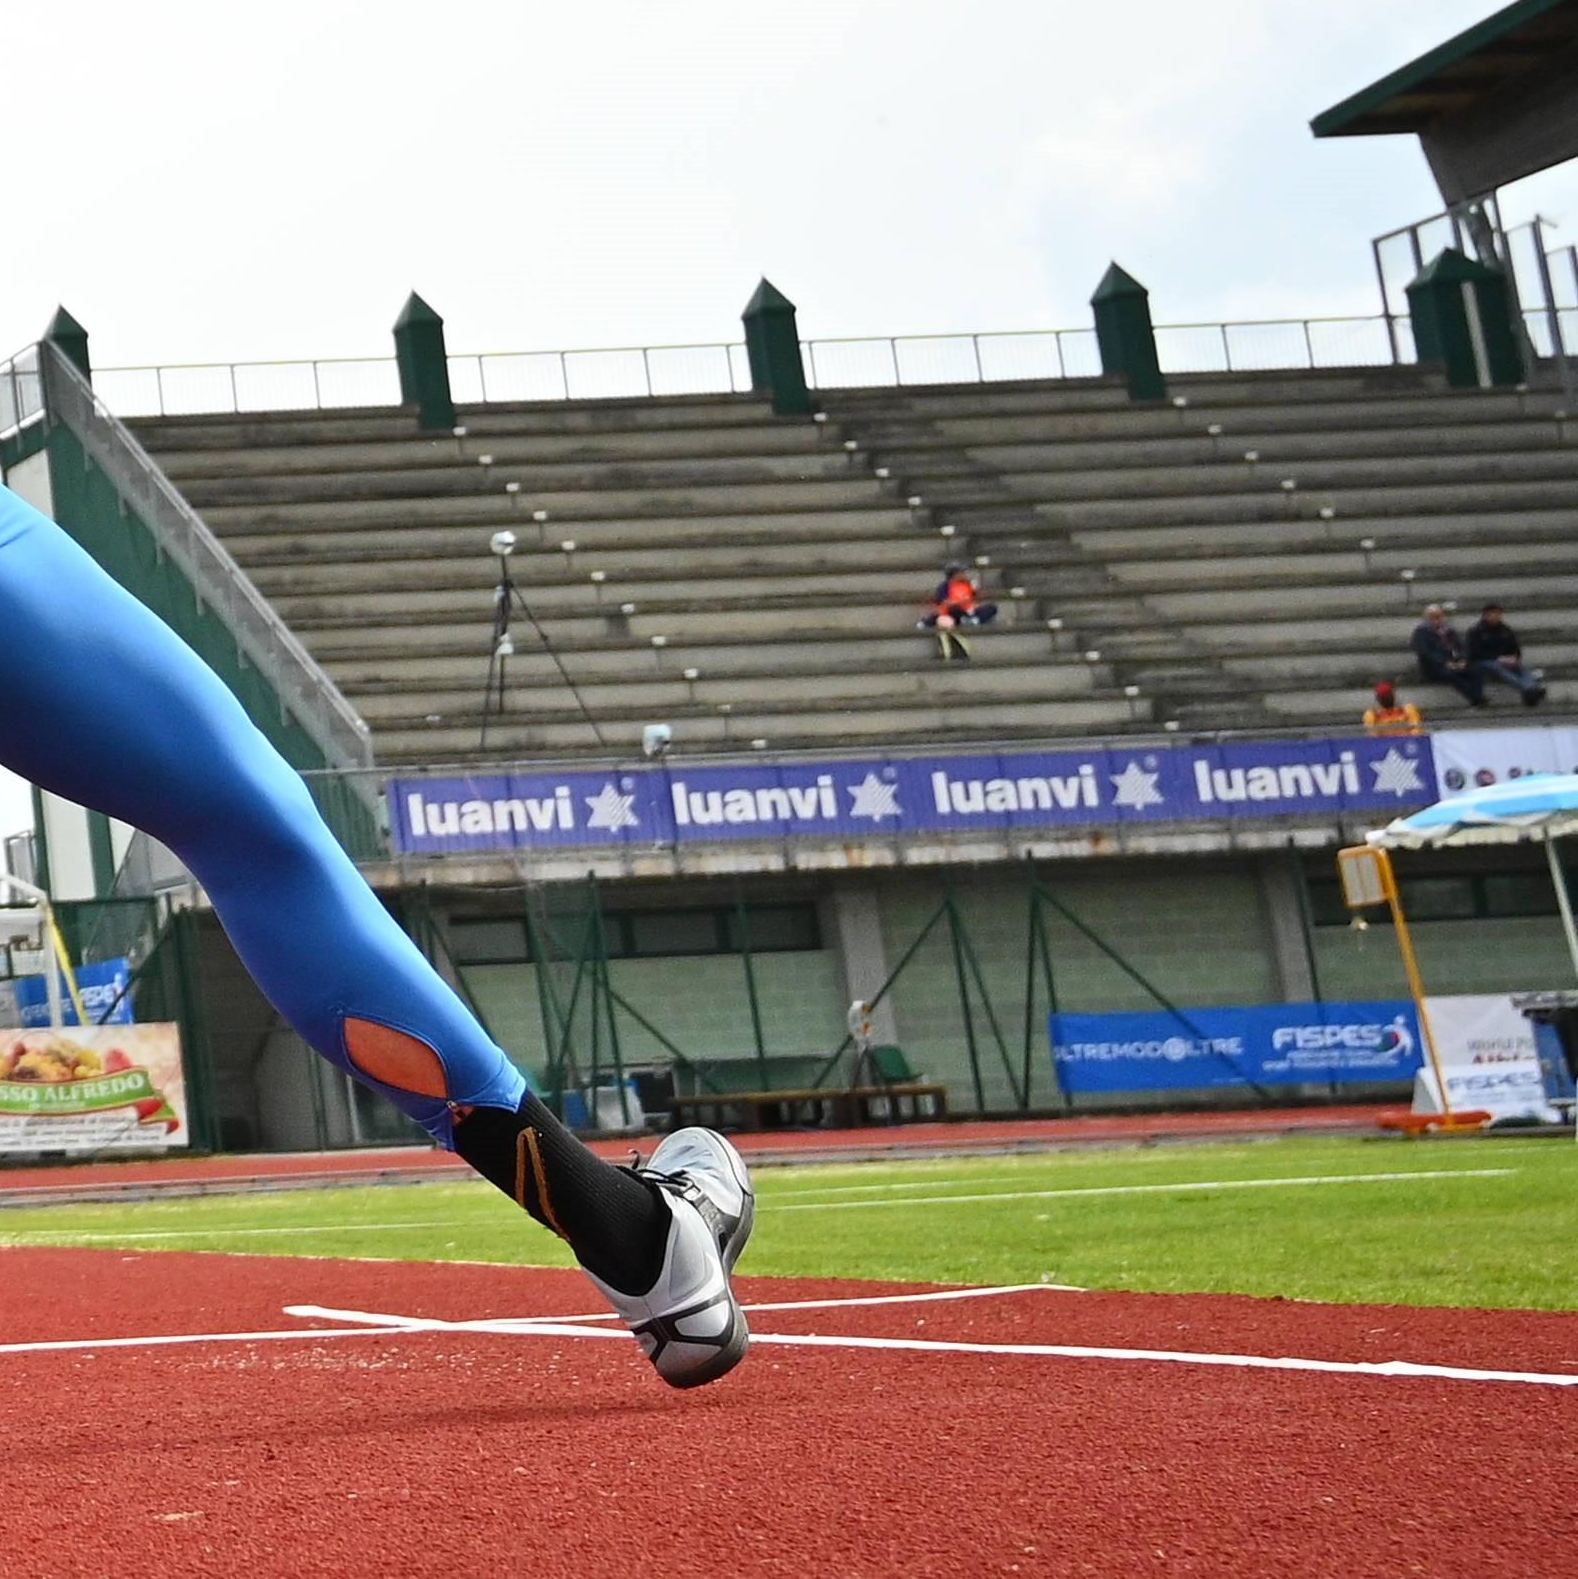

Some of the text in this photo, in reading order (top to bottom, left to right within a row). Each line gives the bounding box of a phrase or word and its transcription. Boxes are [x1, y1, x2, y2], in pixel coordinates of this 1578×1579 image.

[672, 775, 837, 826] luanvi
[930, 765, 1099, 815] luanvi
[1194, 751, 1360, 803] luanvi
[408, 786, 574, 837] luanvi
[1272, 1024, 1381, 1050] FISPES
[44, 1073, 143, 1101] ALFREDO
